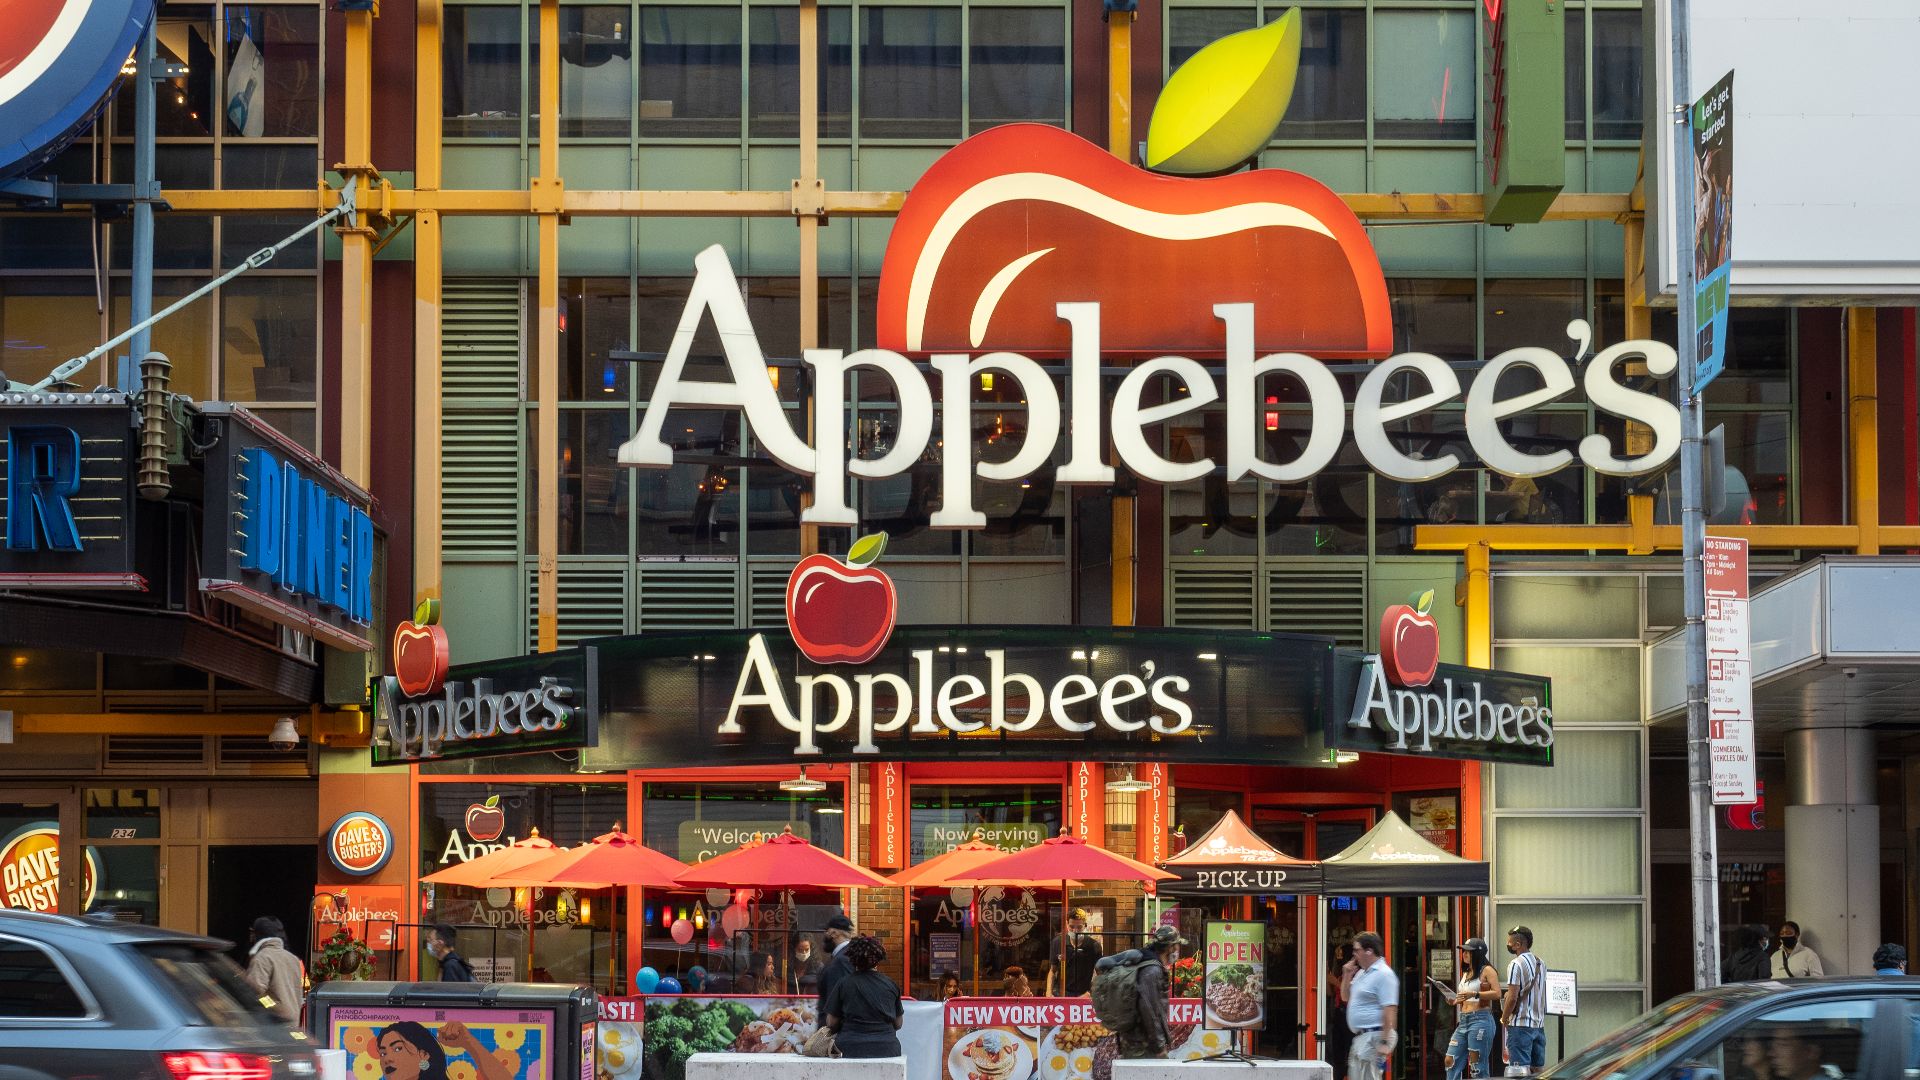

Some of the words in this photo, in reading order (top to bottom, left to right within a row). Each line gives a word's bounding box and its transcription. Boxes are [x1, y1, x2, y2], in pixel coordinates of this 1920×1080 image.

[1702, 97, 1717, 121] Let's
[1717, 86, 1729, 111] get
[1701, 110, 1726, 145] started
[618, 243, 1682, 528] Applebee's
[240, 447, 373, 628] DINER
[1706, 540, 1714, 549] NO
[1715, 541, 1741, 551] STANDING
[718, 633, 1194, 754] Applebee's
[1348, 654, 1554, 751] Applebee's
[371, 676, 573, 759] Applebee's
[1715, 721, 1720, 738] 1
[1713, 745, 1743, 753] COMMERCIAL
[1713, 754, 1735, 762] VEHICLES
[113, 829, 134, 838] 234
[339, 827, 371, 847] DAVE
[371, 827, 381, 841] &
[934, 828, 969, 840] Now
[975, 827, 1038, 843] Serving
[340, 841, 382, 860] BUSTER'S
[1196, 870, 1287, 889] PICK-UP
[321, 904, 399, 925] Applebee's
[1208, 941, 1263, 962] OPEN
[597, 1001, 635, 1020] AST!
[949, 1004, 993, 1025] NEW
[999, 1004, 1065, 1024] YORK'S
[1070, 1003, 1101, 1024] BES
